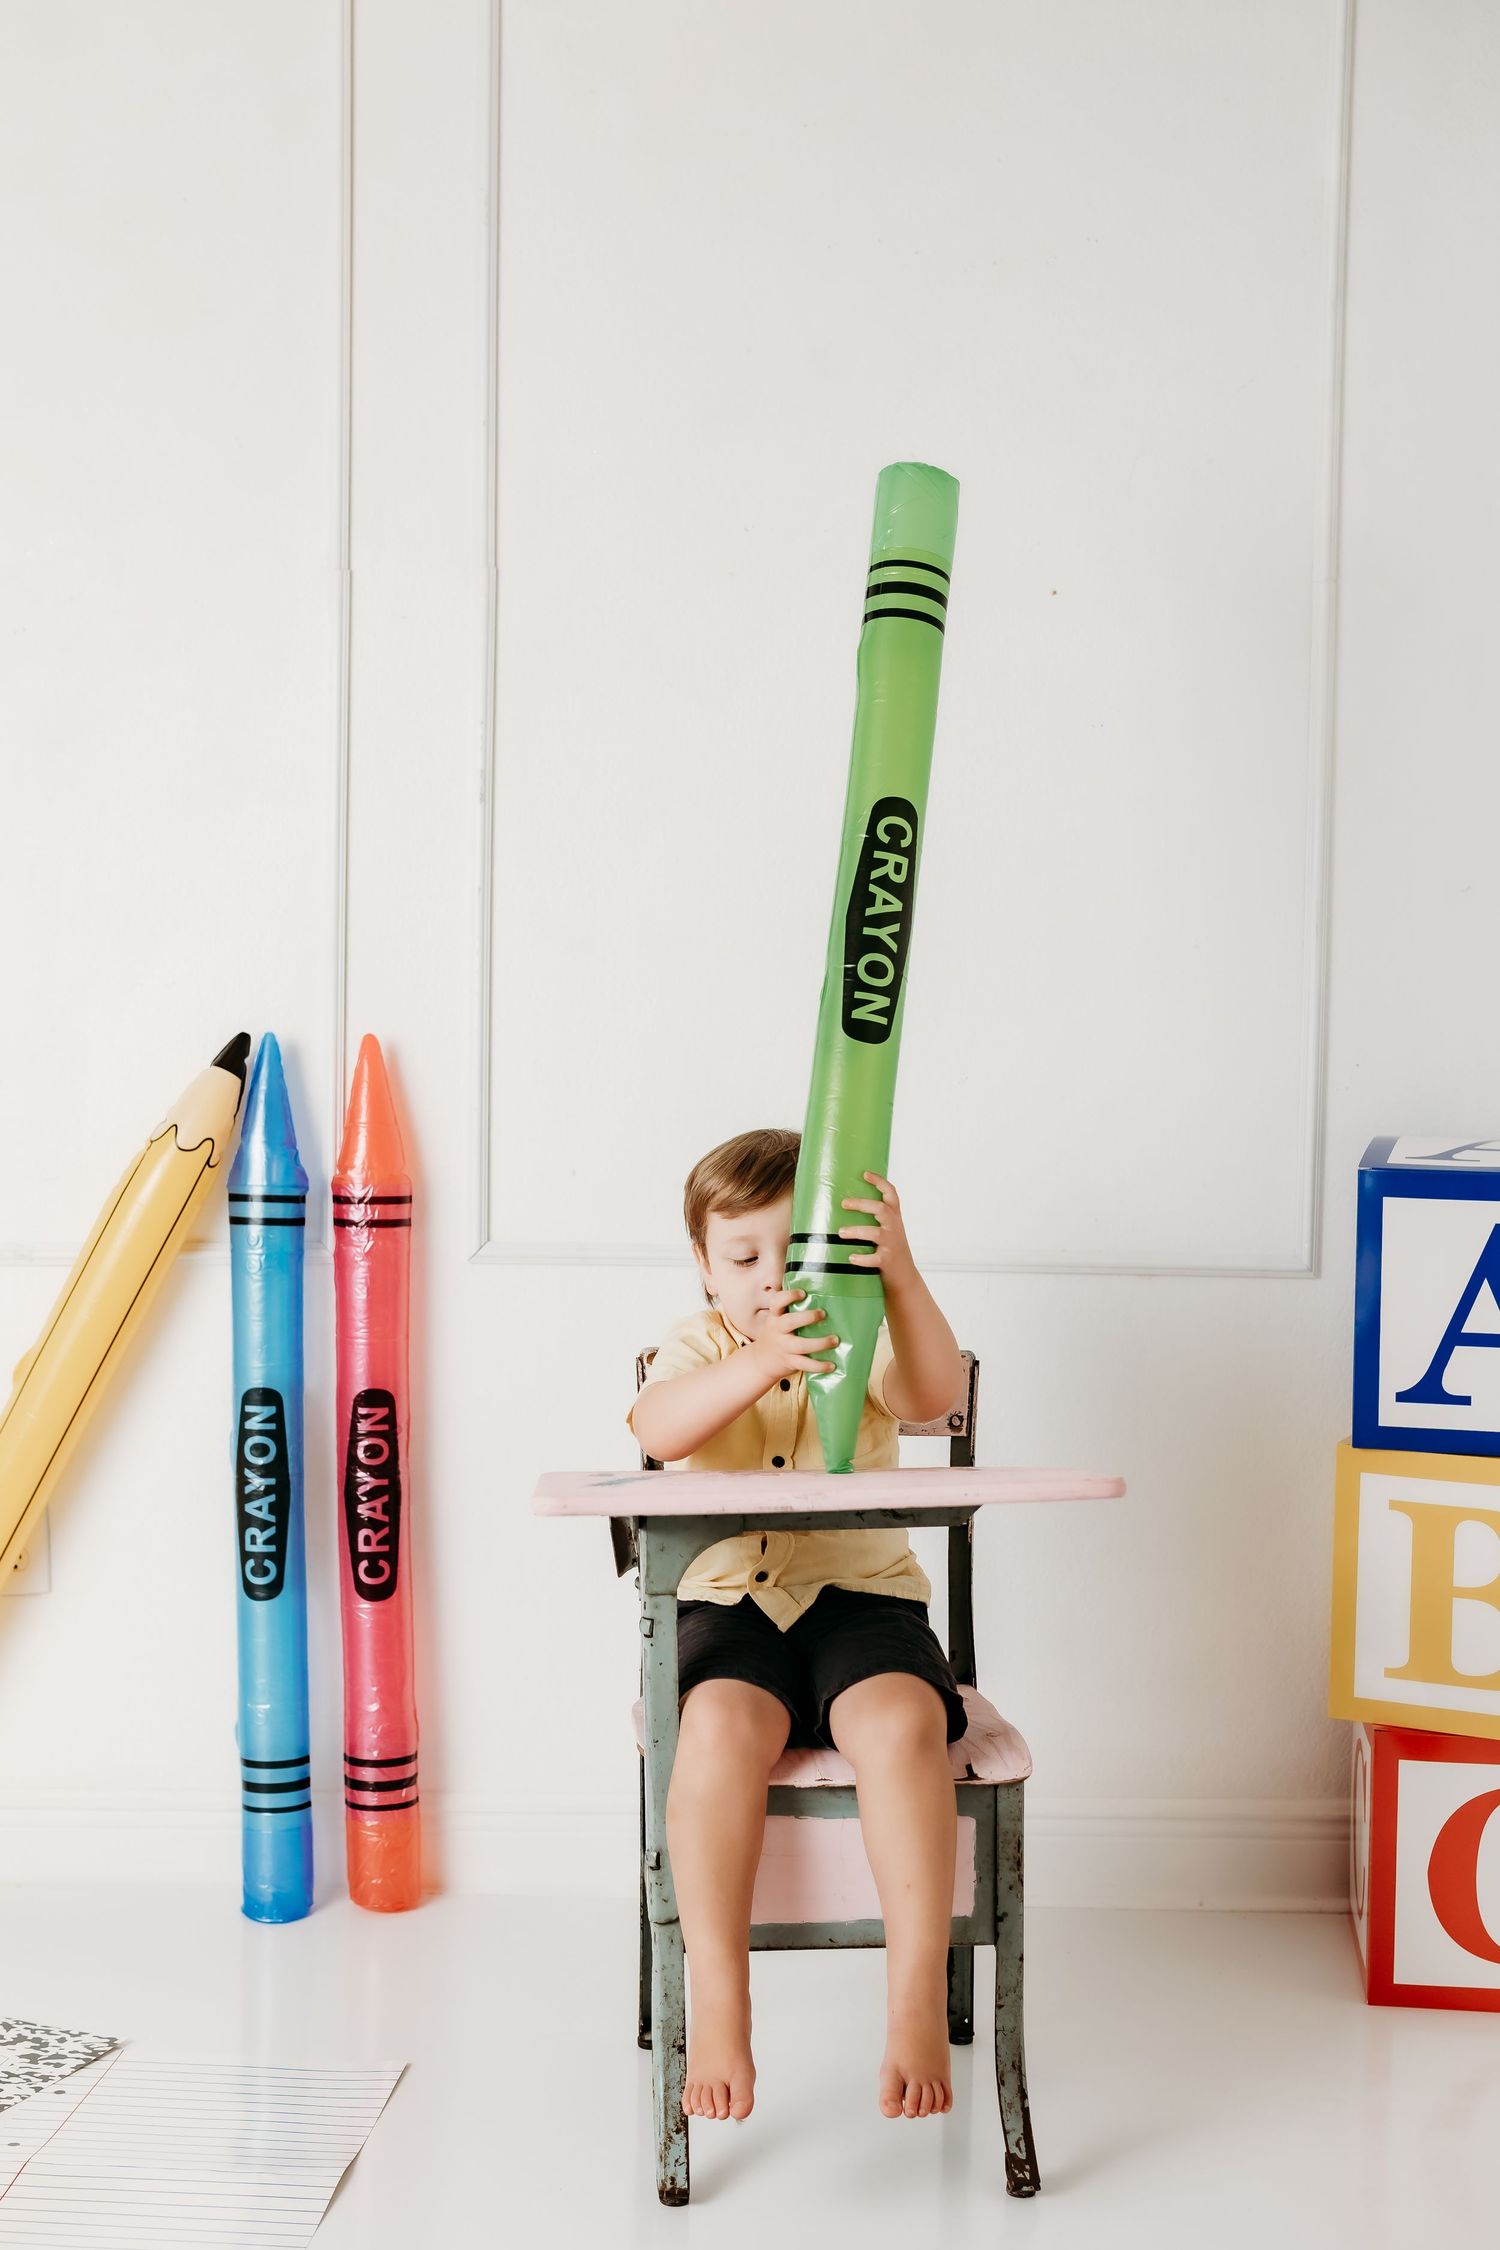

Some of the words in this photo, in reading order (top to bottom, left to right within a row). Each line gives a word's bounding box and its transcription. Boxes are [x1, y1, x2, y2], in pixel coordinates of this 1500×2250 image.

[851, 815, 913, 1026] CRAYON
[244, 1404, 278, 1585] CRAYON
[356, 1406, 391, 1585] CRAYON
